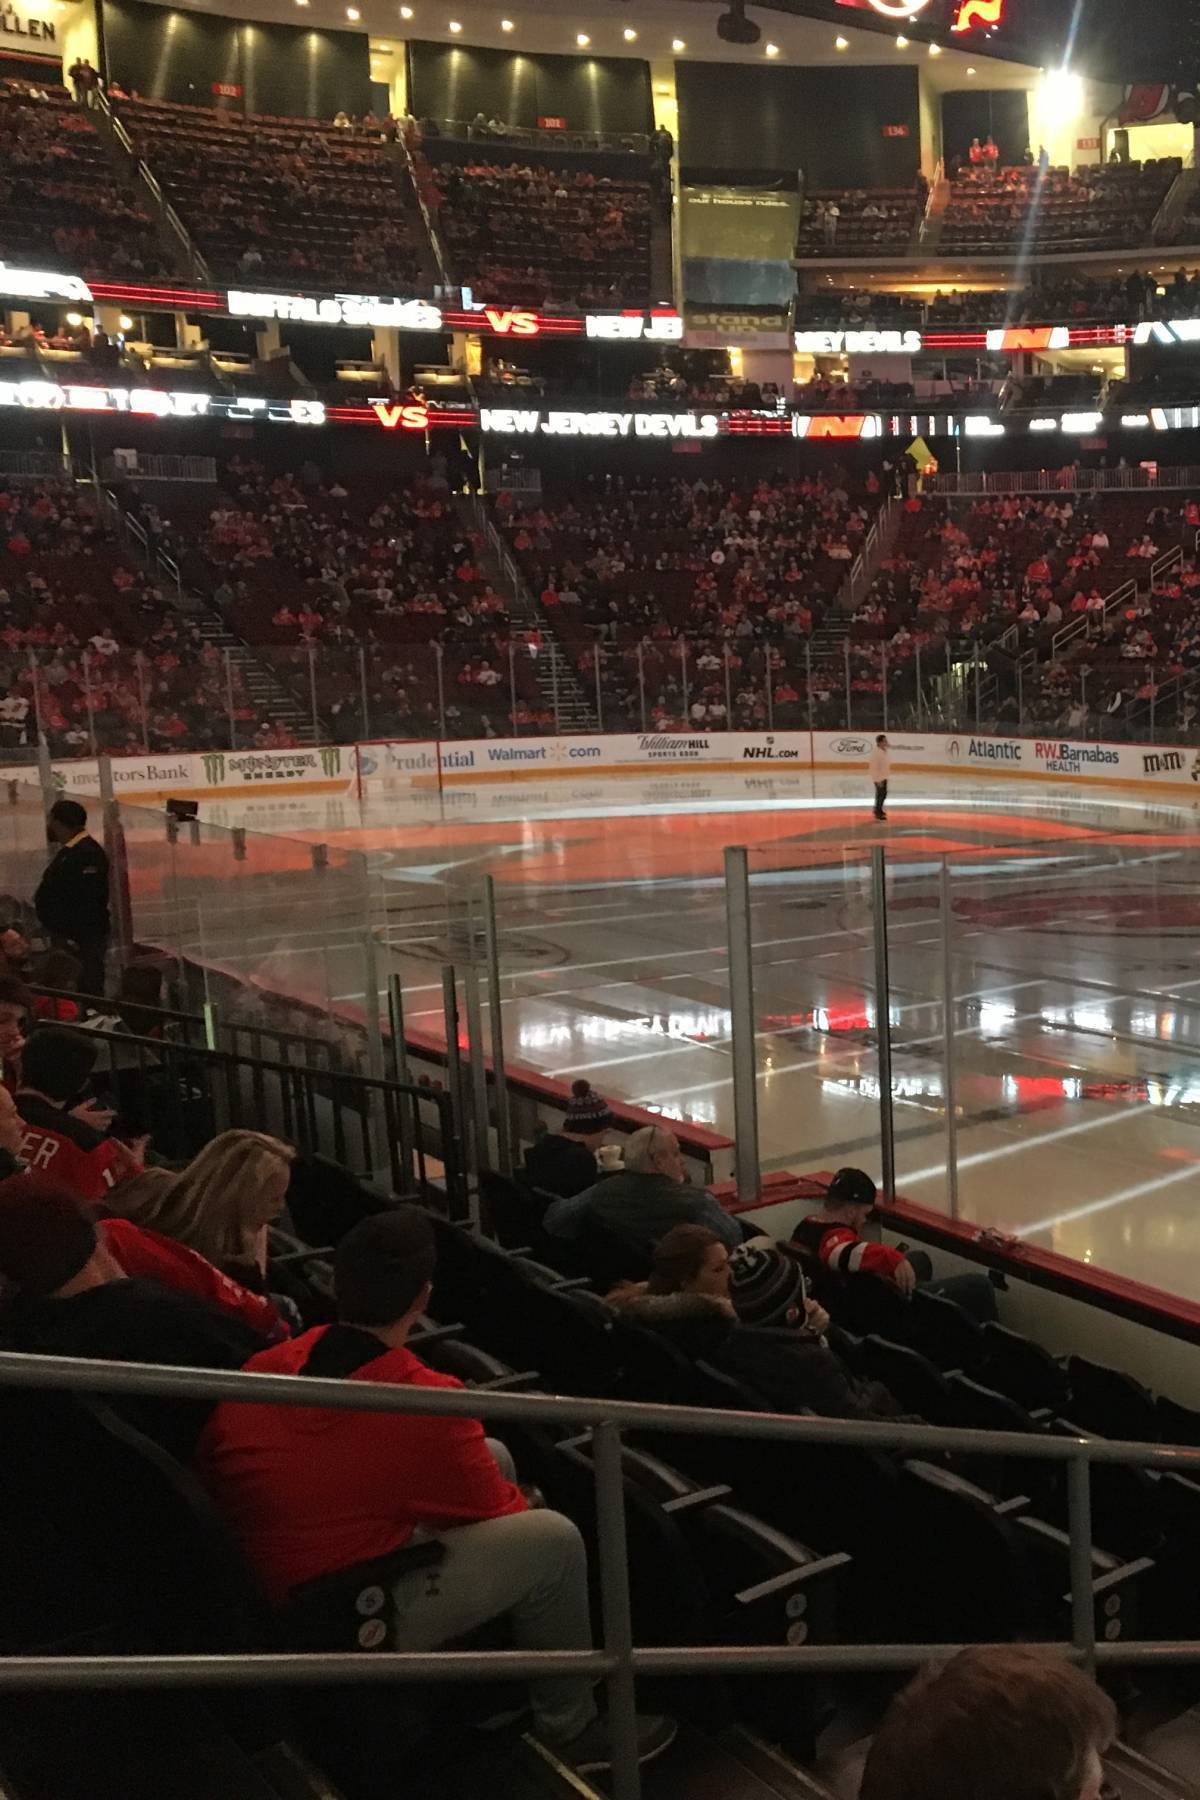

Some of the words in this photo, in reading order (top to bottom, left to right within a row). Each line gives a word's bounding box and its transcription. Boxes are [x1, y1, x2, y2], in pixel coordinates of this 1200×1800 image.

[484, 309, 539, 335] VS
[692, 314, 782, 327] stand
[373, 404, 428, 428] VS
[480, 408, 538, 433] NEW
[541, 411, 632, 436] JERSEY
[634, 413, 718, 437] DEVILS
[637, 735, 687, 750] William
[688, 739, 710, 749] HILL
[837, 739, 866, 753] Ford
[968, 738, 1022, 760] Atlantic
[488, 747, 546, 761] Walmart
[1046, 761, 1081, 773] HEALTH
[72, 770, 146, 786] invetors
[243, 769, 305, 780] ENERGY
